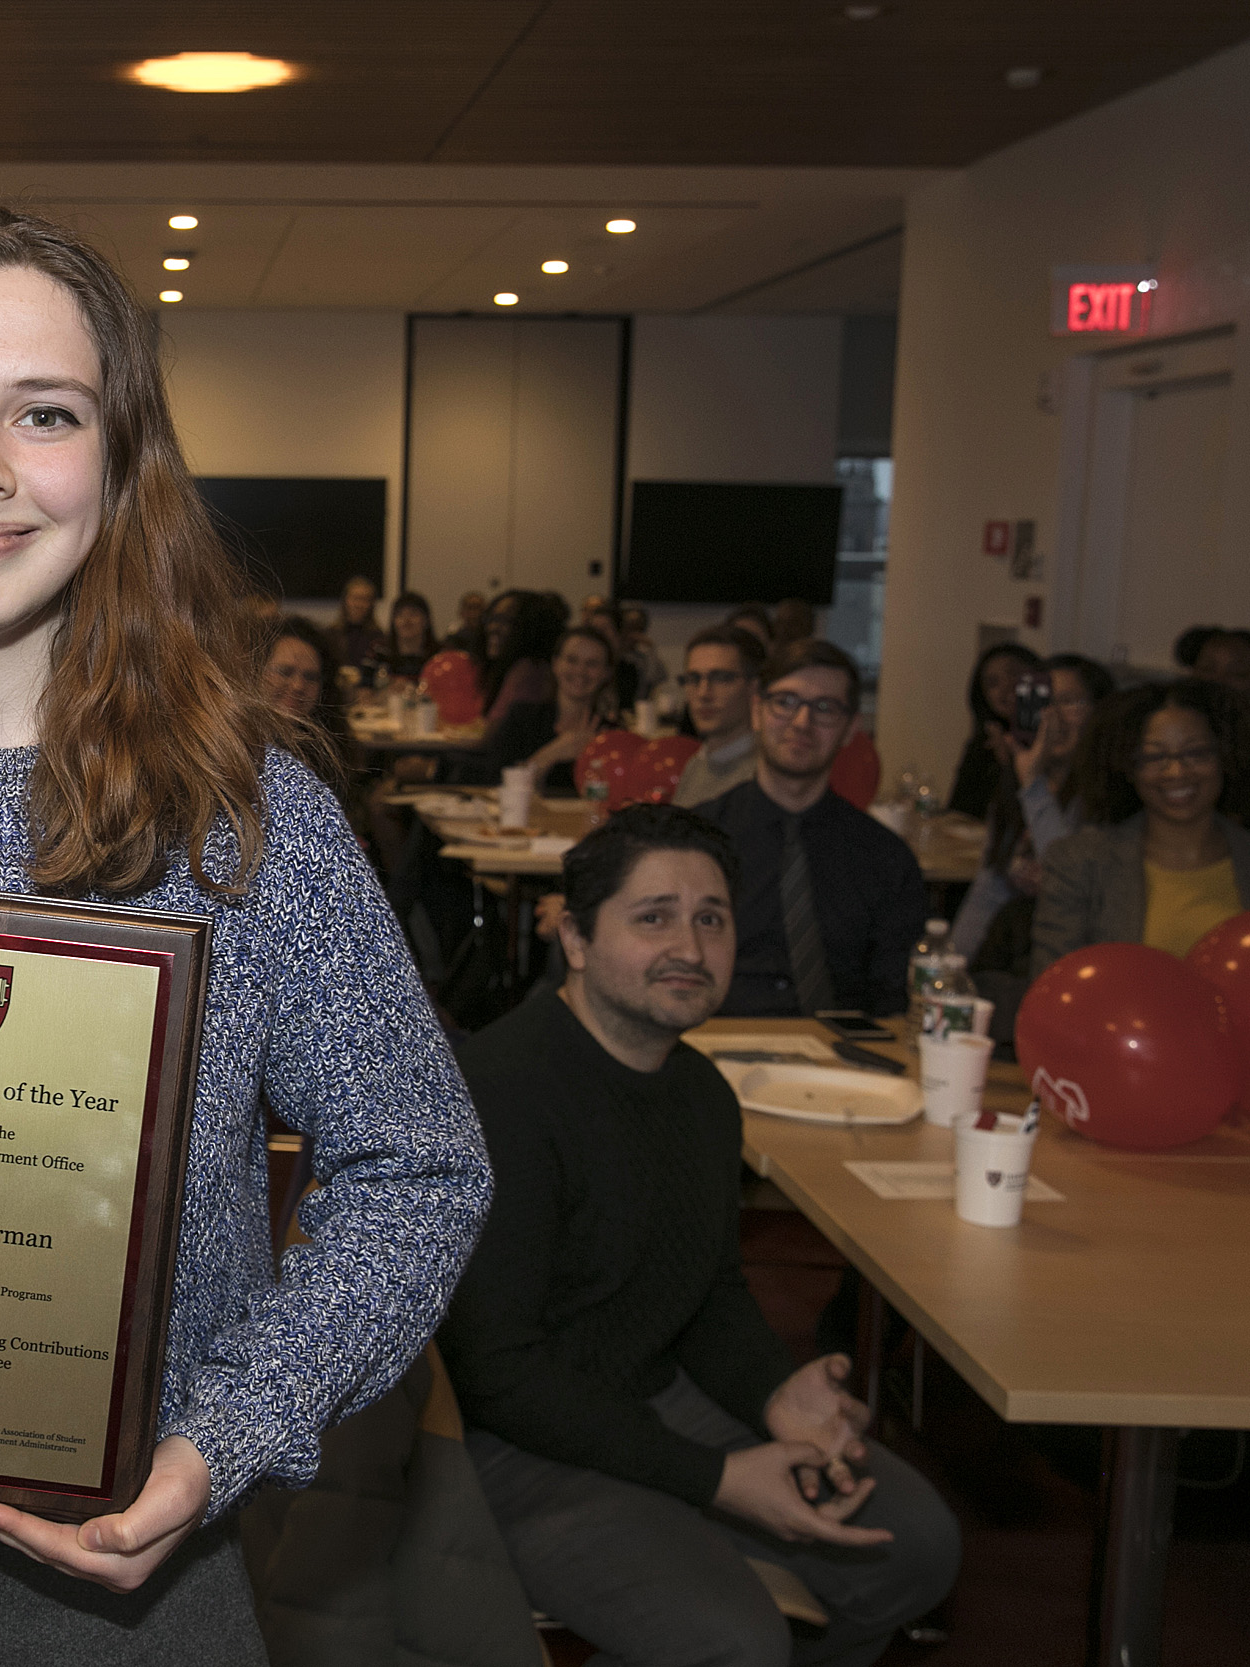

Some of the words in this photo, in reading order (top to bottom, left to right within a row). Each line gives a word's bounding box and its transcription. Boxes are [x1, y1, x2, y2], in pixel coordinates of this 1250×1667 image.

[1068, 283, 1136, 332] EXIT
[4, 1082, 27, 1101] of
[30, 1084, 64, 1106] the
[70, 1089, 119, 1112] Year
[42, 1155, 84, 1172] Office
[1, 1286, 52, 1303] Programs
[10, 1337, 109, 1360] Contributions
[1, 1428, 44, 1439] Association
[56, 1434, 86, 1444] Student
[19, 1440, 77, 1453] Administrators
